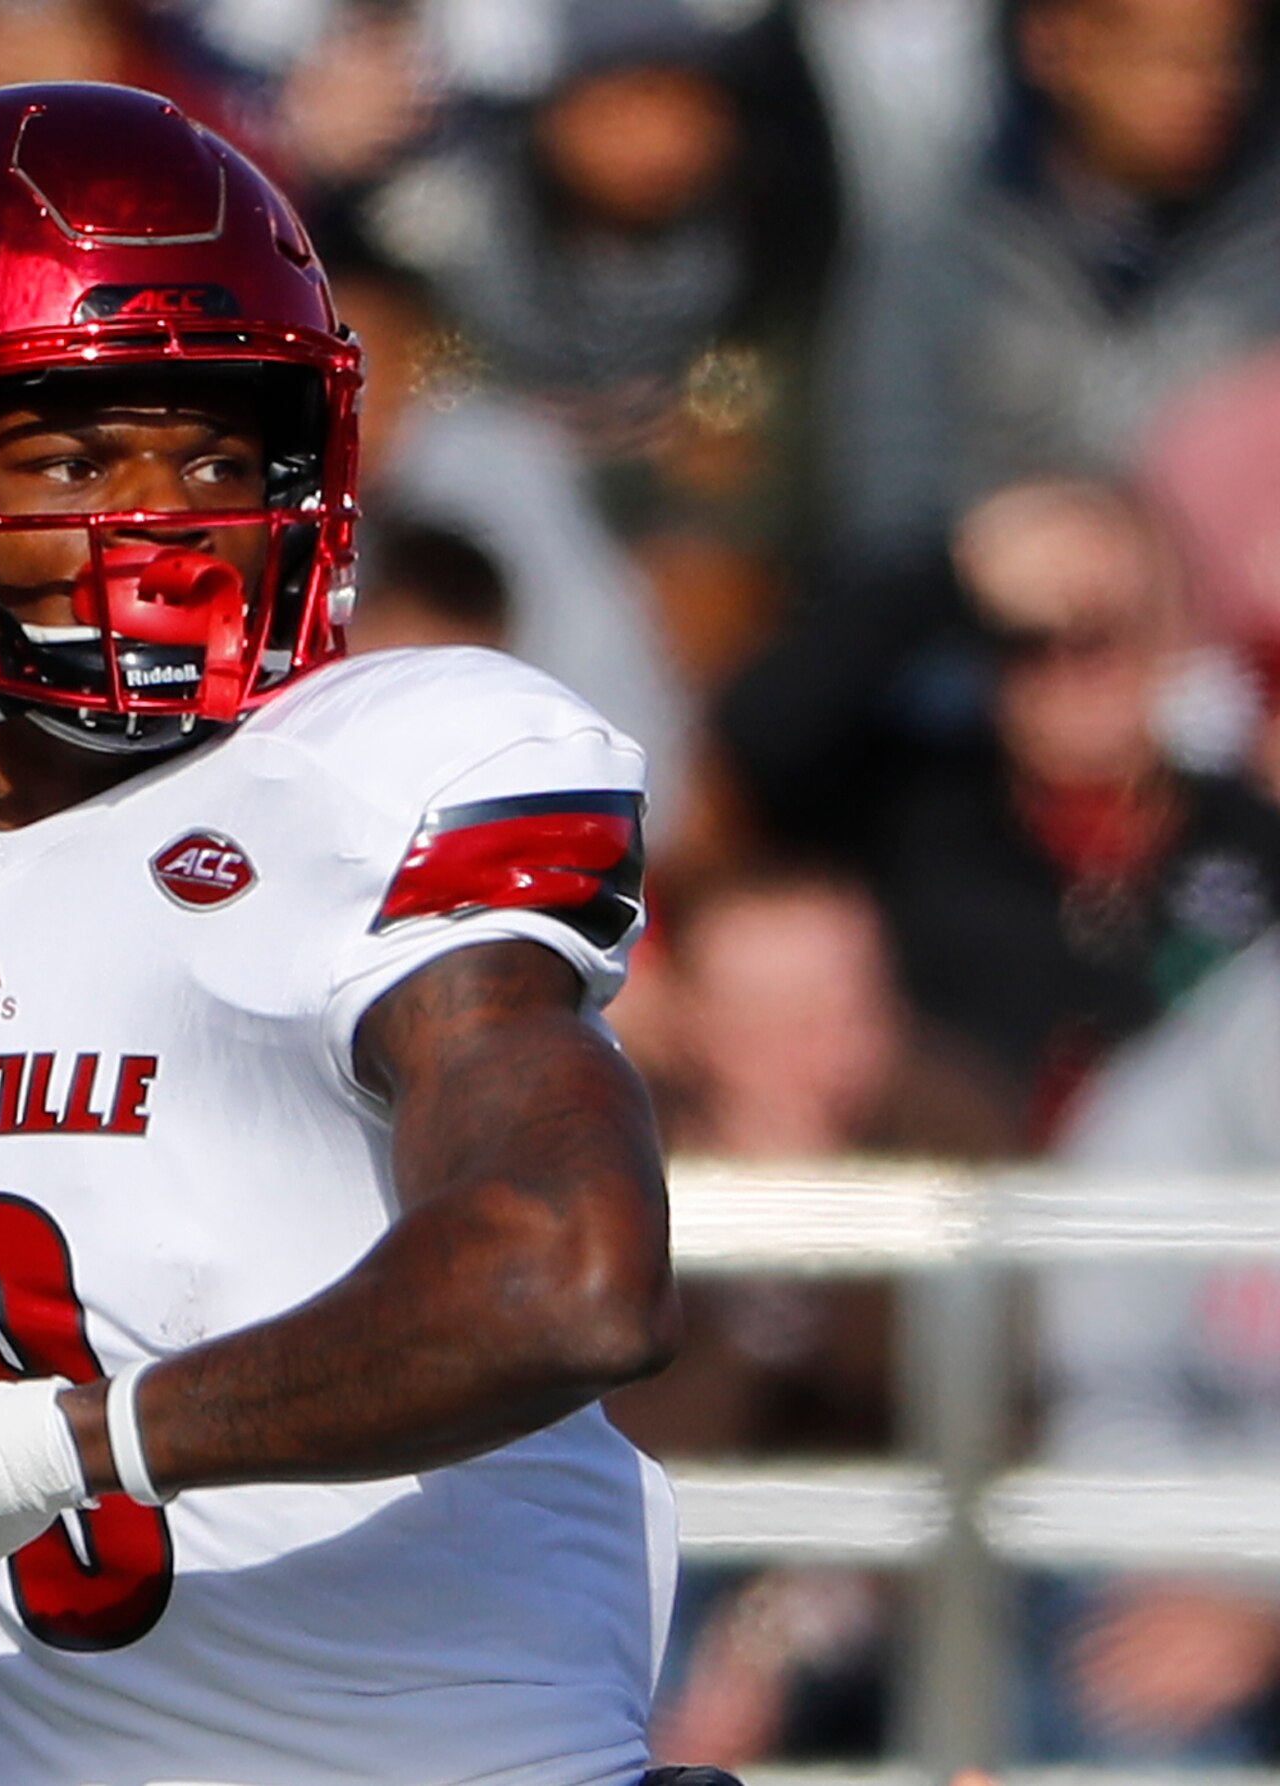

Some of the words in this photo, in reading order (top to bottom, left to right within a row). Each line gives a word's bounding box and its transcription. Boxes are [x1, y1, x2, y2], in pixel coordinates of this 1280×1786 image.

[121, 288, 207, 312] ACC
[126, 664, 201, 687] Riddell
[164, 848, 243, 882] ACC
